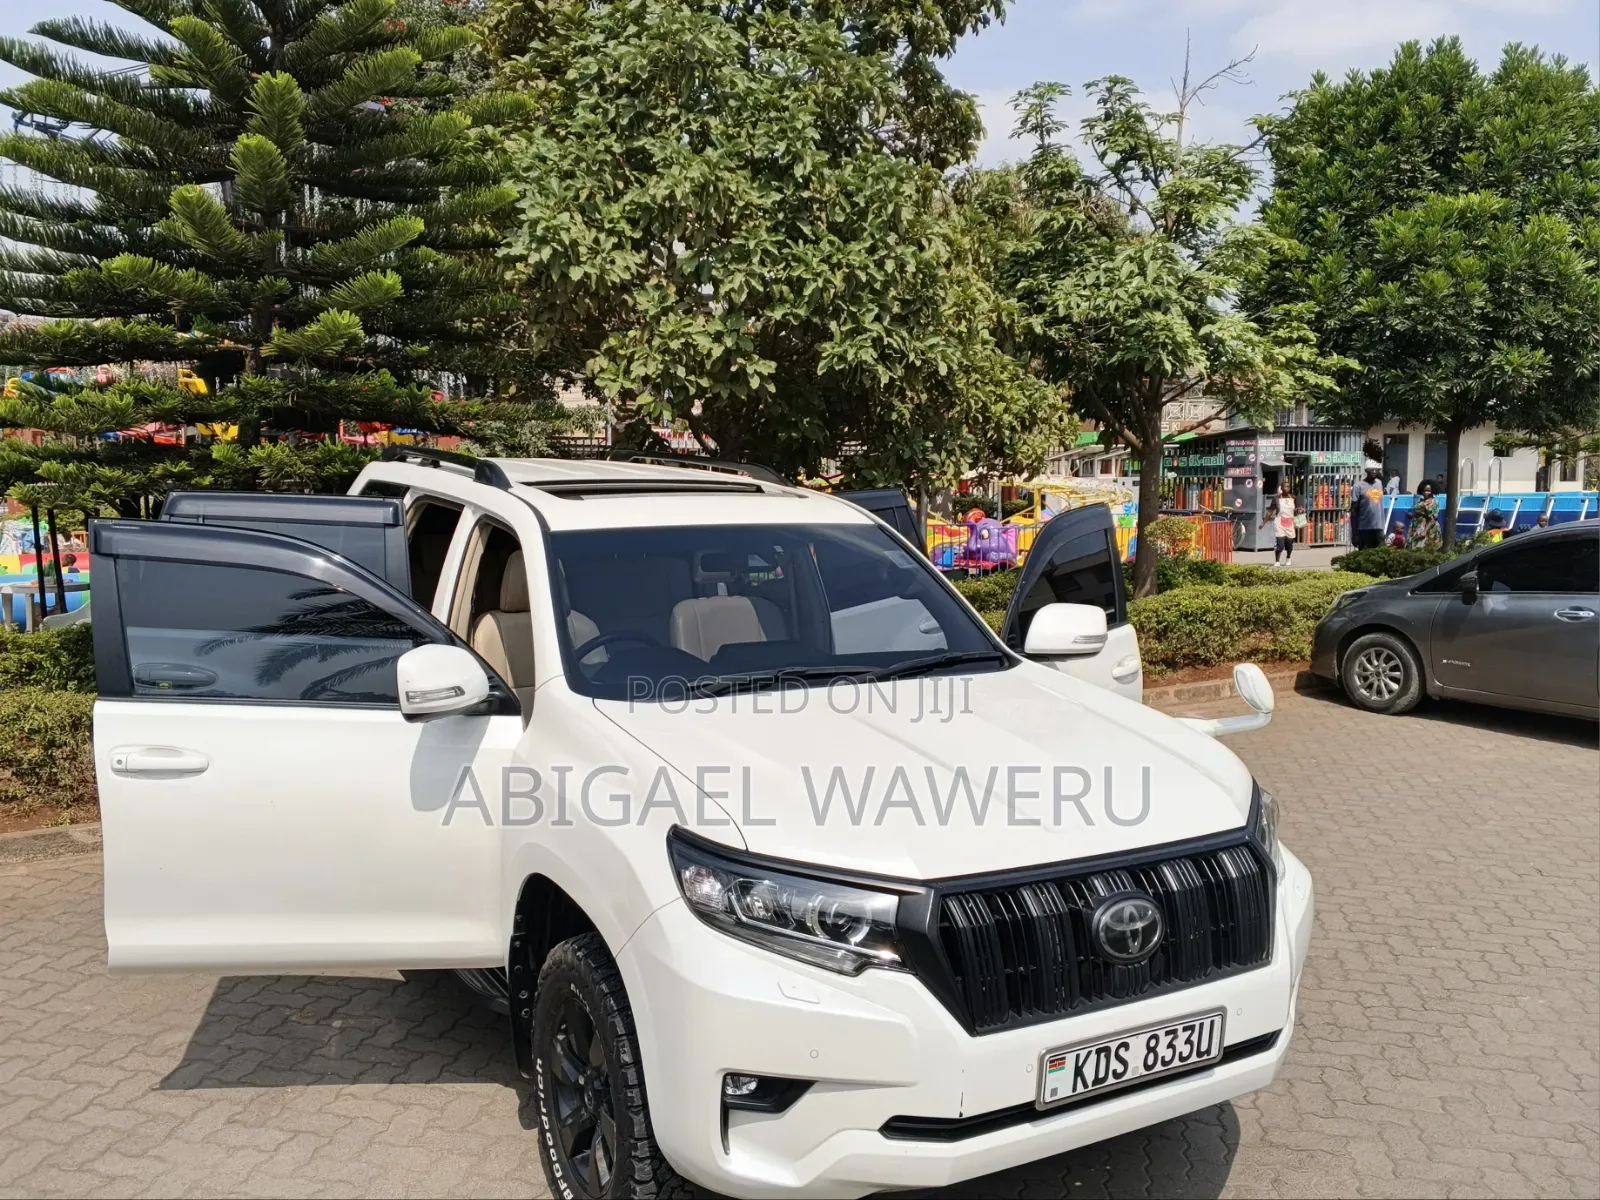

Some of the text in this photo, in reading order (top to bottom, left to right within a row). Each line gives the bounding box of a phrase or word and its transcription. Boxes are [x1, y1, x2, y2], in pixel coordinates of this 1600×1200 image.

[1072, 1019, 1215, 1093] KDS 833U
[536, 1058, 574, 1200] BFGoodrich
